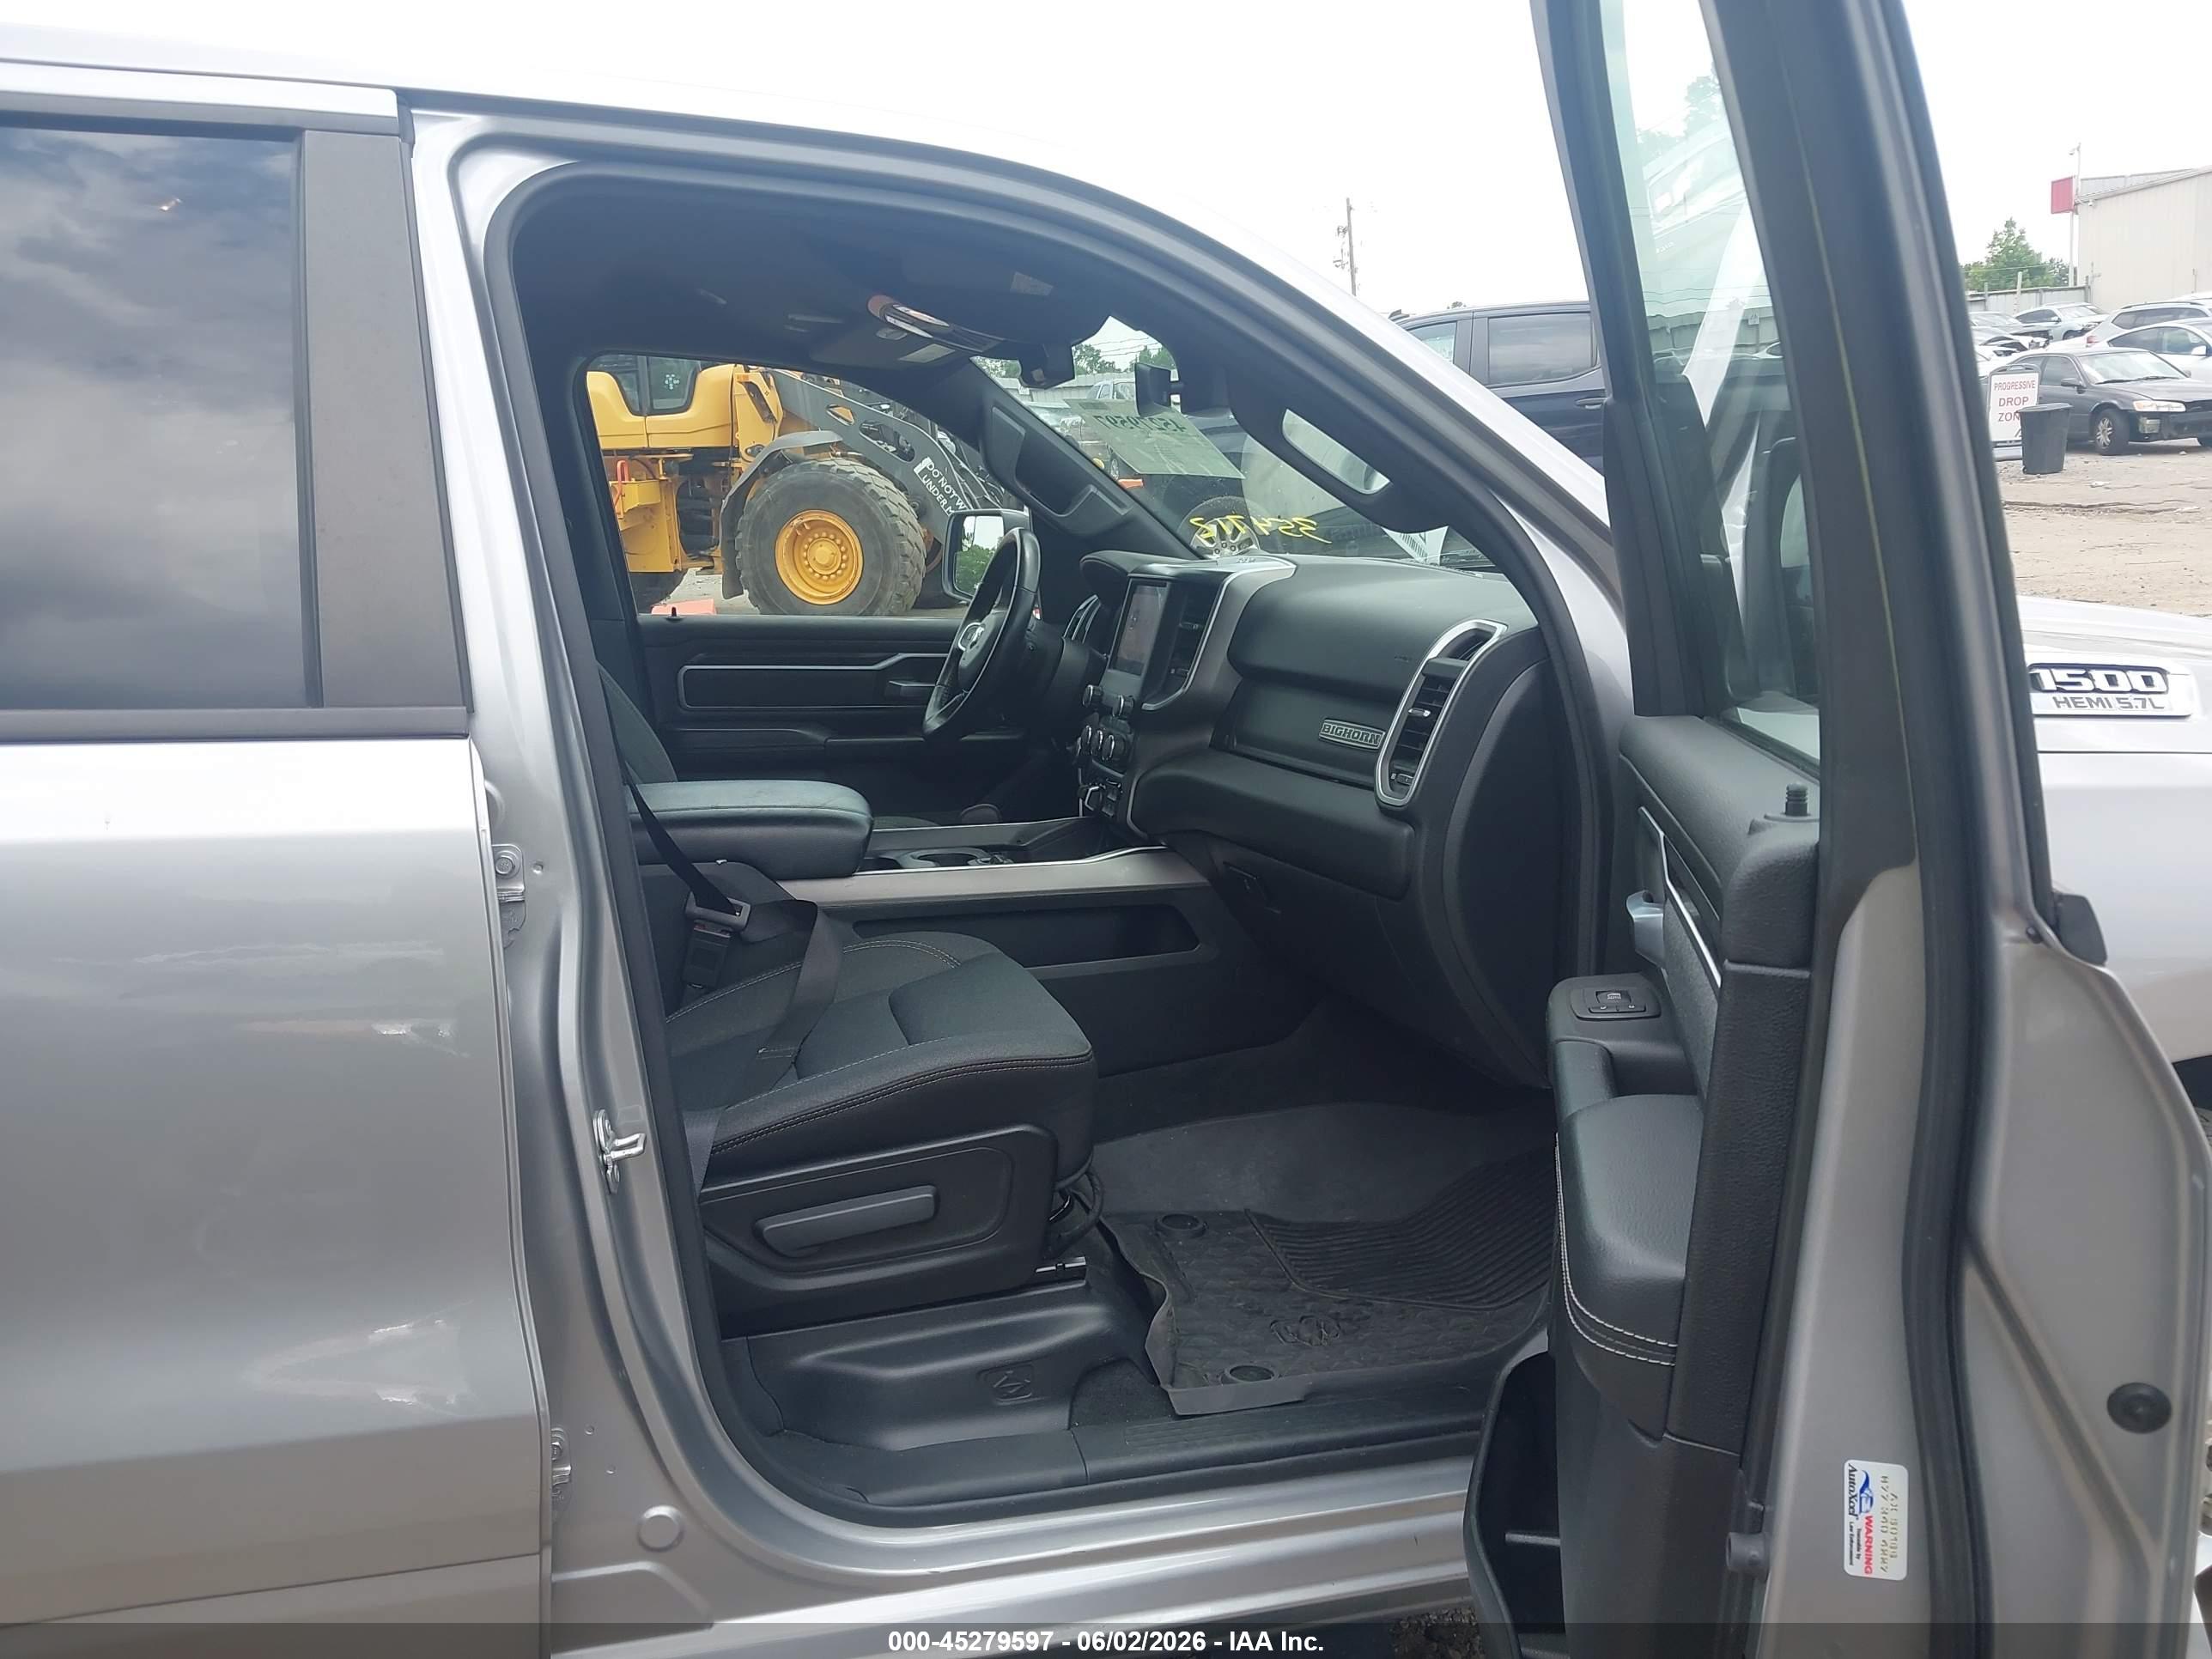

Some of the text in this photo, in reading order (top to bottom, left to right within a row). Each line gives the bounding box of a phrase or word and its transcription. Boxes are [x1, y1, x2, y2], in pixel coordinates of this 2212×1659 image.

[1994, 380, 2036, 391] PROGRESSIVE
[1998, 396, 2029, 407] DROP
[1998, 412, 2021, 422] ZON
[922, 474, 948, 507] UNDER
[927, 462, 940, 477] DO
[938, 477, 957, 498] NOT
[2027, 665, 2169, 694] 1500
[2052, 696, 2165, 709] HEMI 5.7L
[1321, 722, 1382, 745] BIGHORN
[1848, 1463, 1859, 1517] AutoXcel
[1864, 1515, 1874, 1575] WARNING
